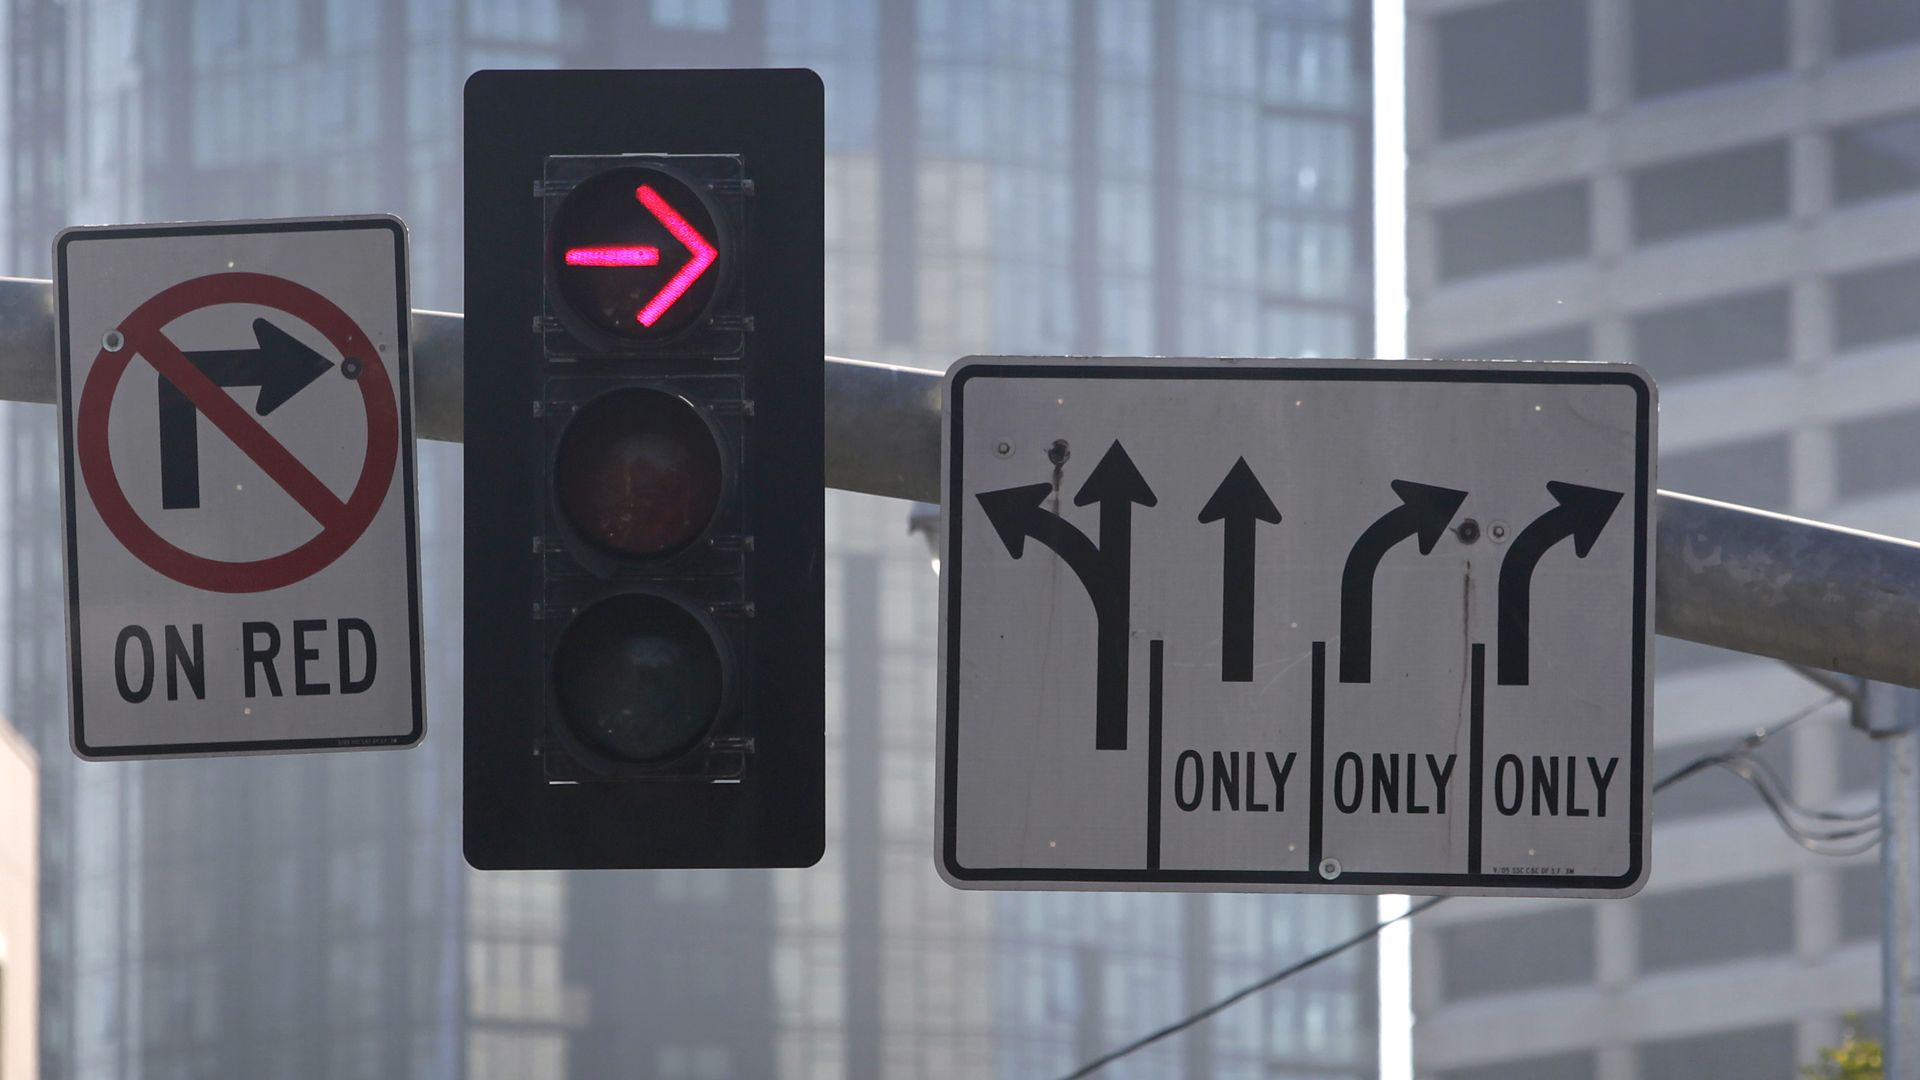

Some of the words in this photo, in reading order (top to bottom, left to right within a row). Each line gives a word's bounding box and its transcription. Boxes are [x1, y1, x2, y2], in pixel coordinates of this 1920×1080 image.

[115, 624, 205, 704] ON
[242, 618, 377, 698] RED
[1175, 750, 1297, 812] ONLY
[1334, 752, 1457, 814] ONLY
[1495, 754, 1619, 817] ONLY
